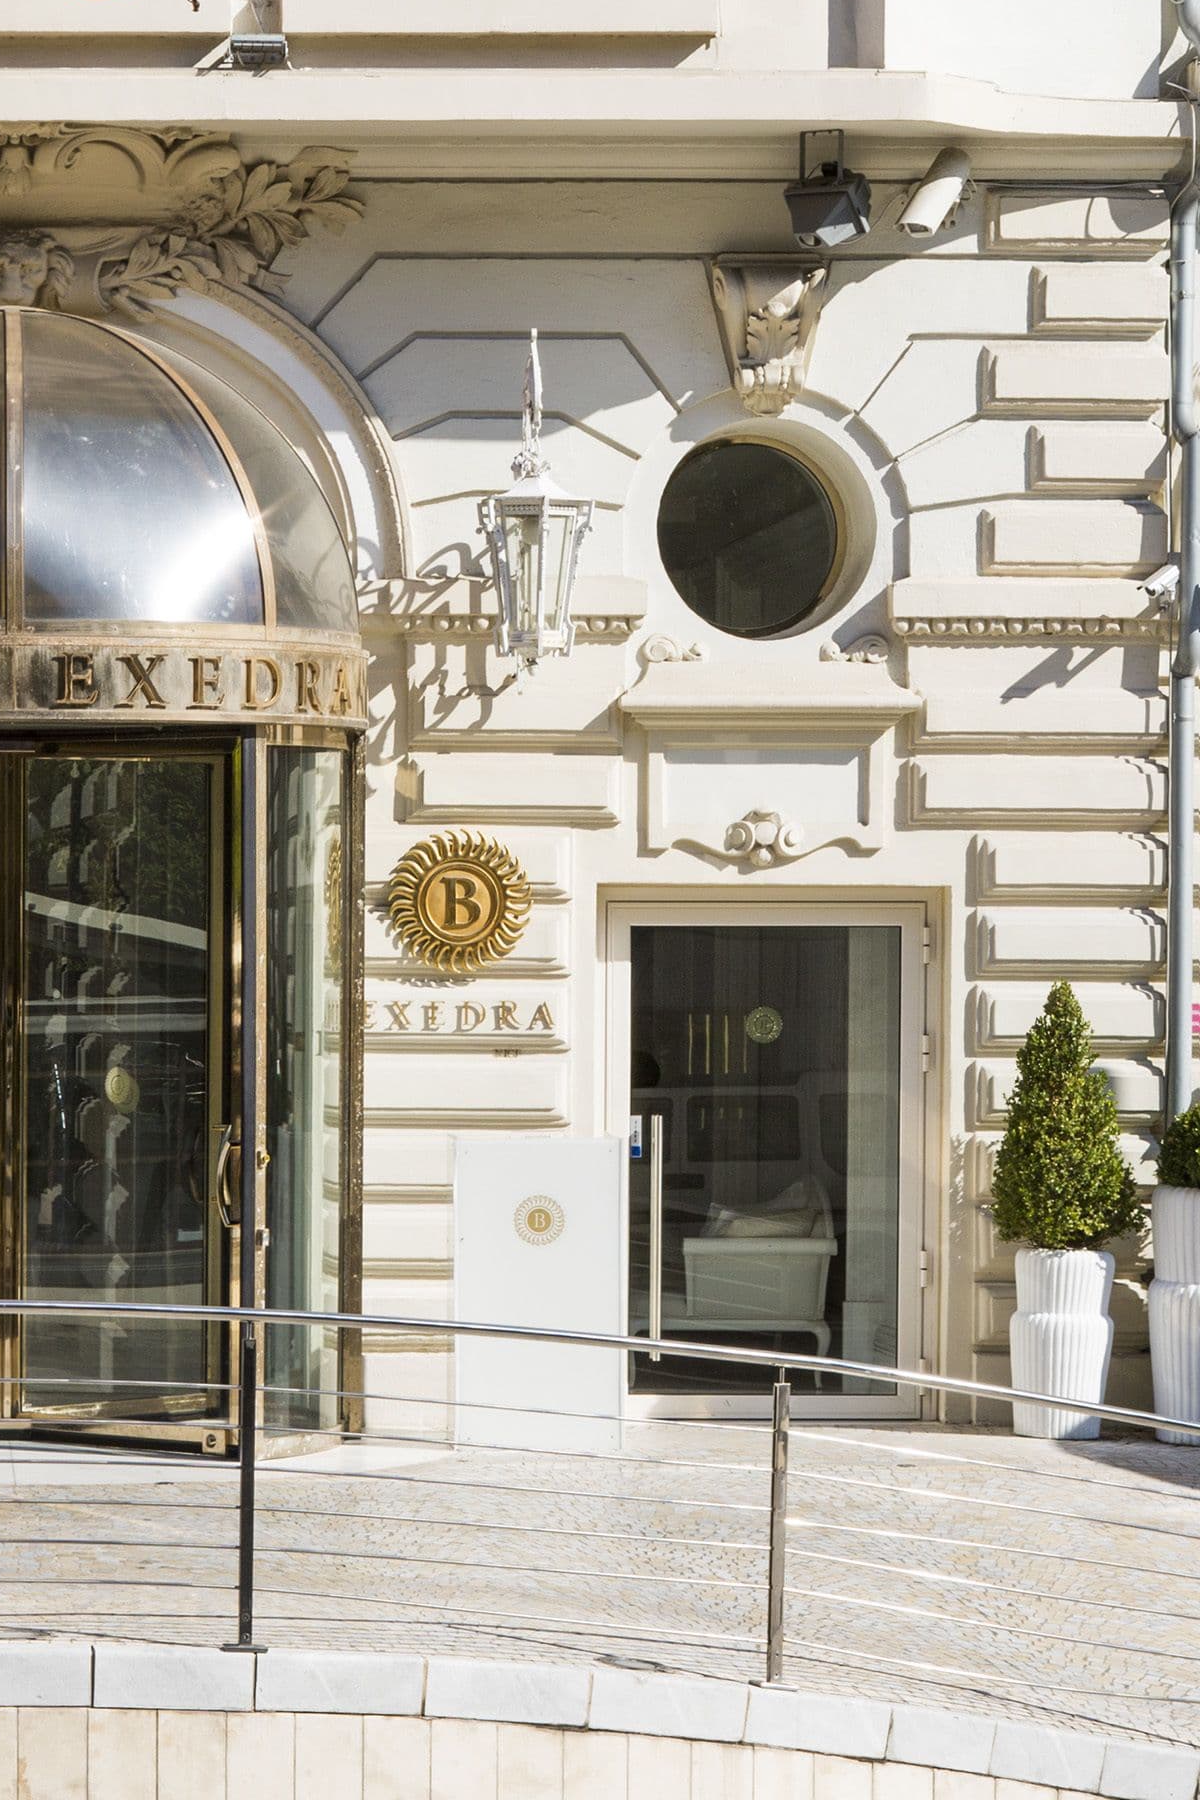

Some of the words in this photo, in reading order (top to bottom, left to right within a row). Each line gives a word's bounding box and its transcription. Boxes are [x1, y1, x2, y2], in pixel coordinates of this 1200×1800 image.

[52, 653, 352, 716] EXEDRA
[440, 877, 482, 929] B
[534, 1212, 546, 1228] B
